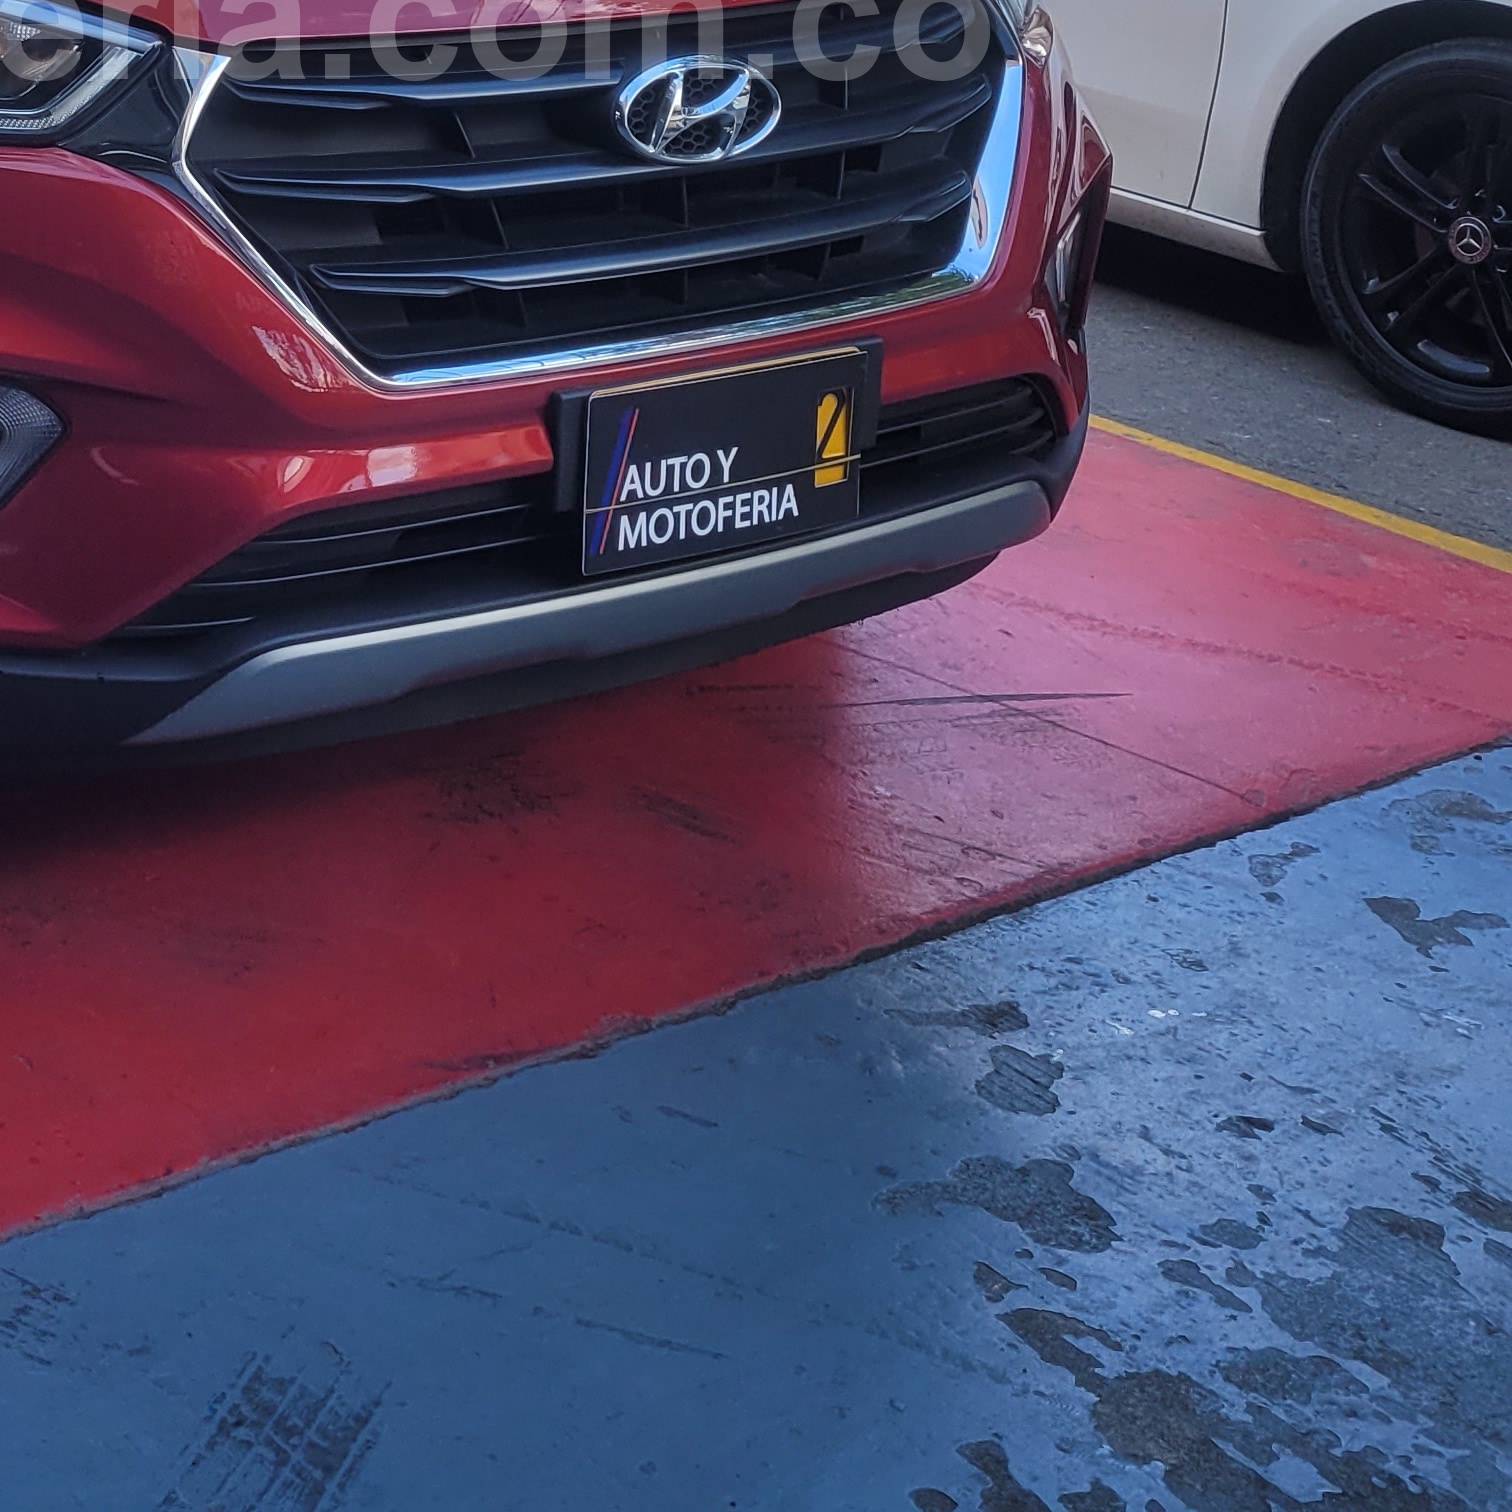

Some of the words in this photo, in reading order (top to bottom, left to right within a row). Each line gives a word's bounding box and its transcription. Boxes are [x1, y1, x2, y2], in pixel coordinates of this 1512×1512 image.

[619, 452, 710, 502] AUTO
[717, 447, 739, 483] Y
[617, 483, 799, 551] MOTOFERIA
